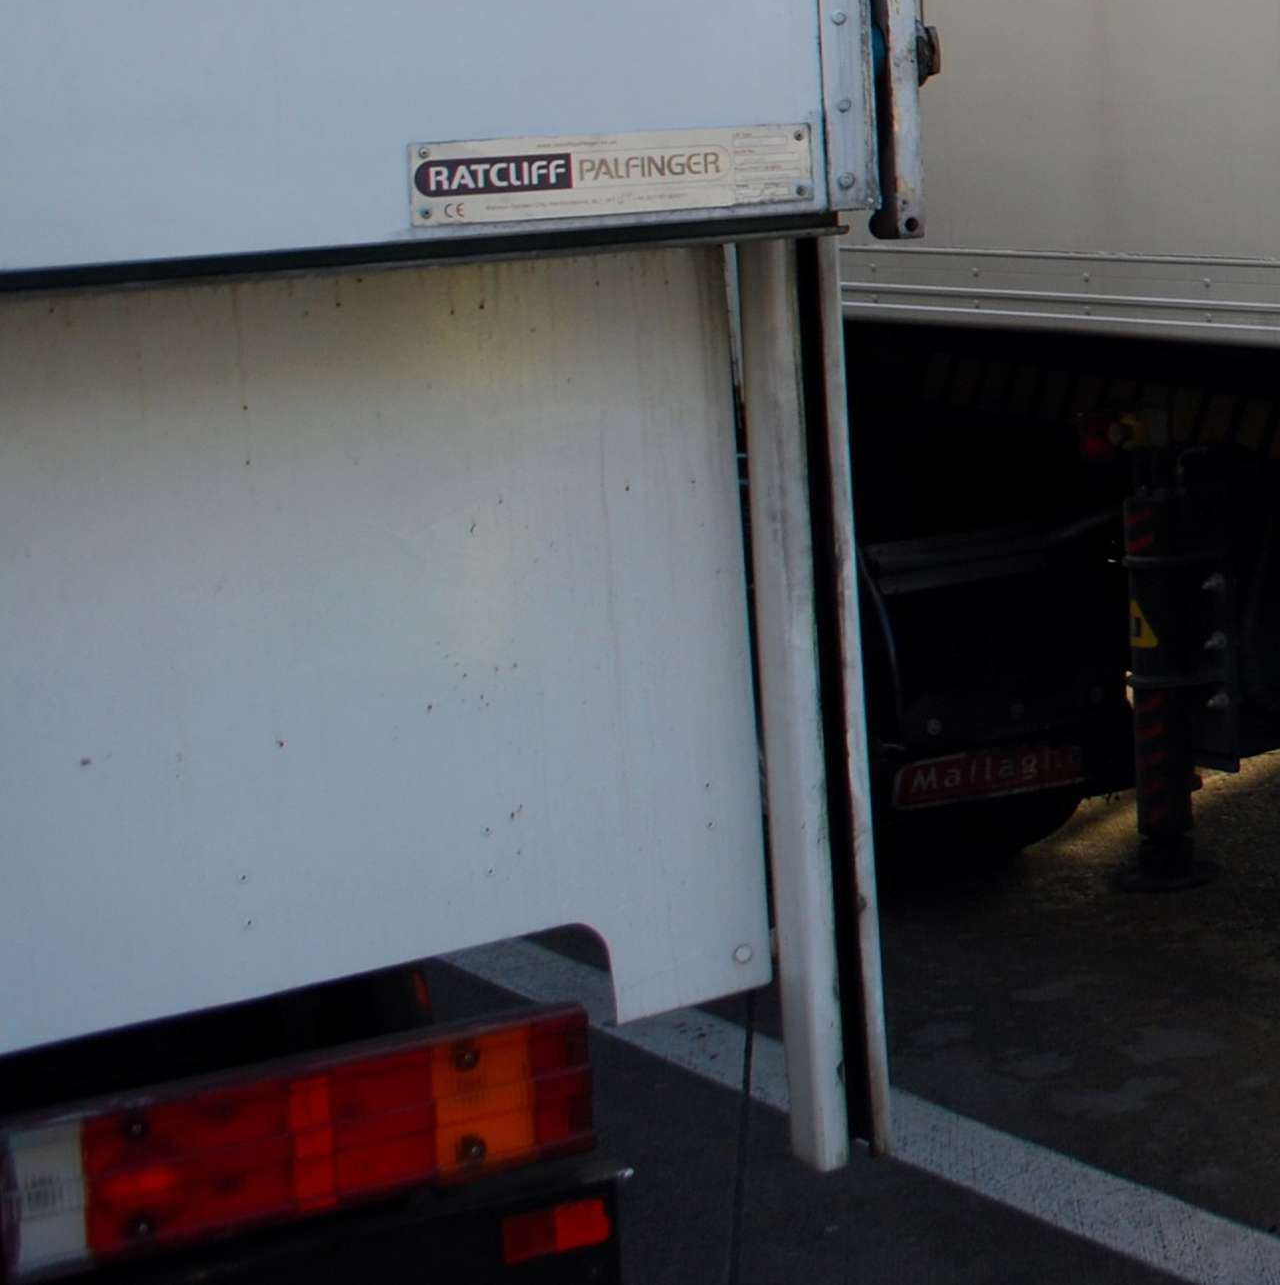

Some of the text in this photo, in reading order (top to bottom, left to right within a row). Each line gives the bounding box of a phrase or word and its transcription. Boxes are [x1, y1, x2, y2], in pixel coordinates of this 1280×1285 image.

[427, 158, 567, 192] RATCLIFF
[578, 151, 721, 182] PALFINGER
[909, 746, 1080, 794] Mallag
